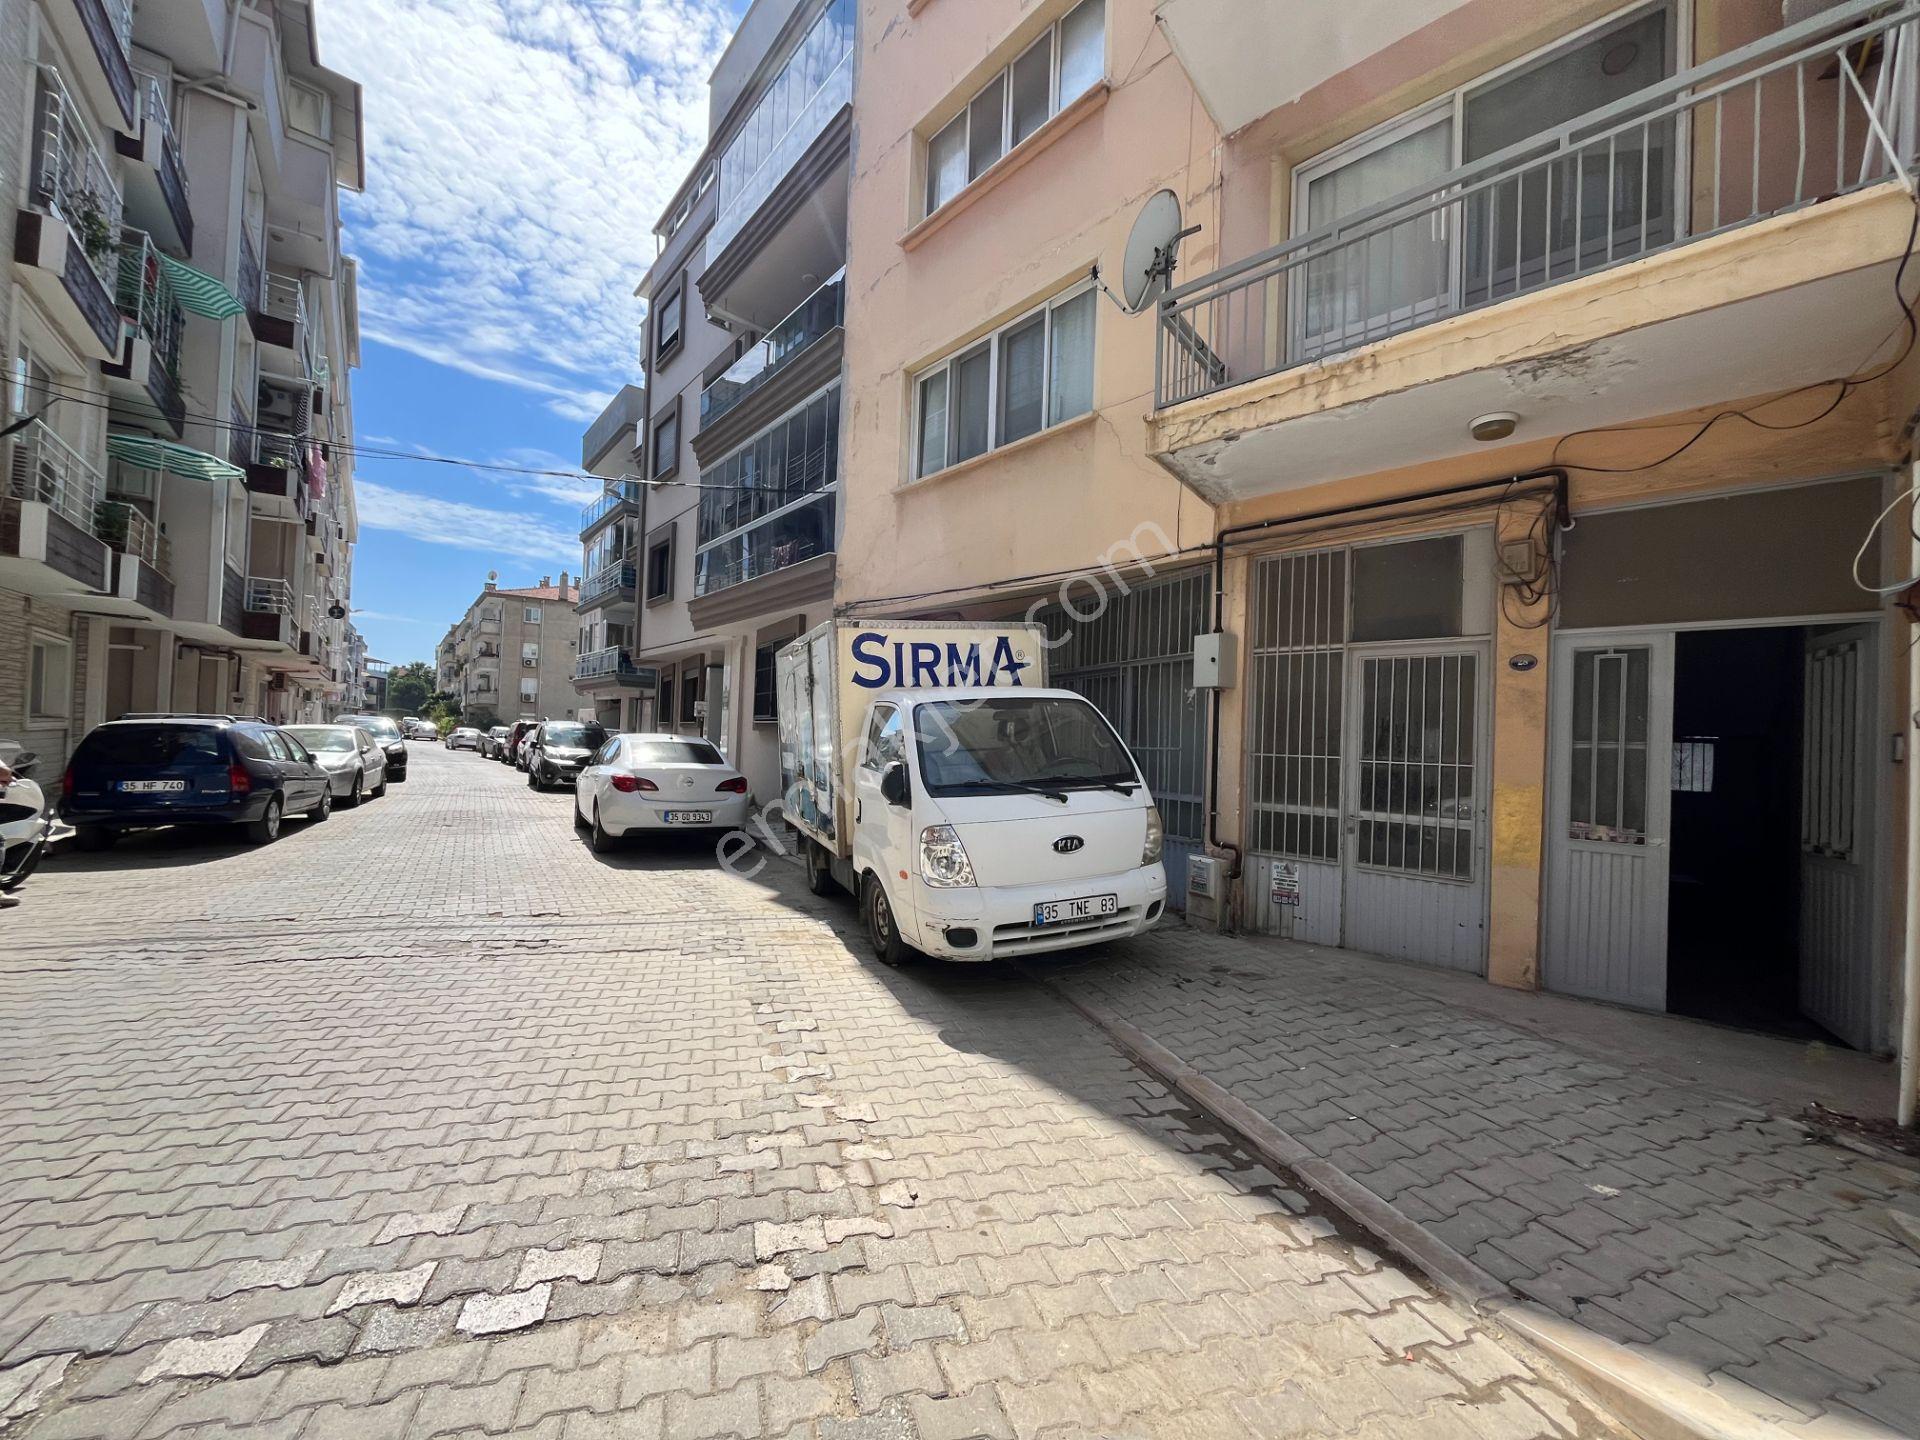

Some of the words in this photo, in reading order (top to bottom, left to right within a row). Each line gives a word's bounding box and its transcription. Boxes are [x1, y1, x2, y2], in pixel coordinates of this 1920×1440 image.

[122, 782, 136, 791] 35
[142, 782, 157, 790] HF
[162, 781, 183, 790] 740
[669, 813, 679, 821] 35
[1057, 838, 1081, 851] KIA
[1044, 904, 1059, 920] 35
[1069, 900, 1091, 917] TNE
[1100, 897, 1115, 912] 83
